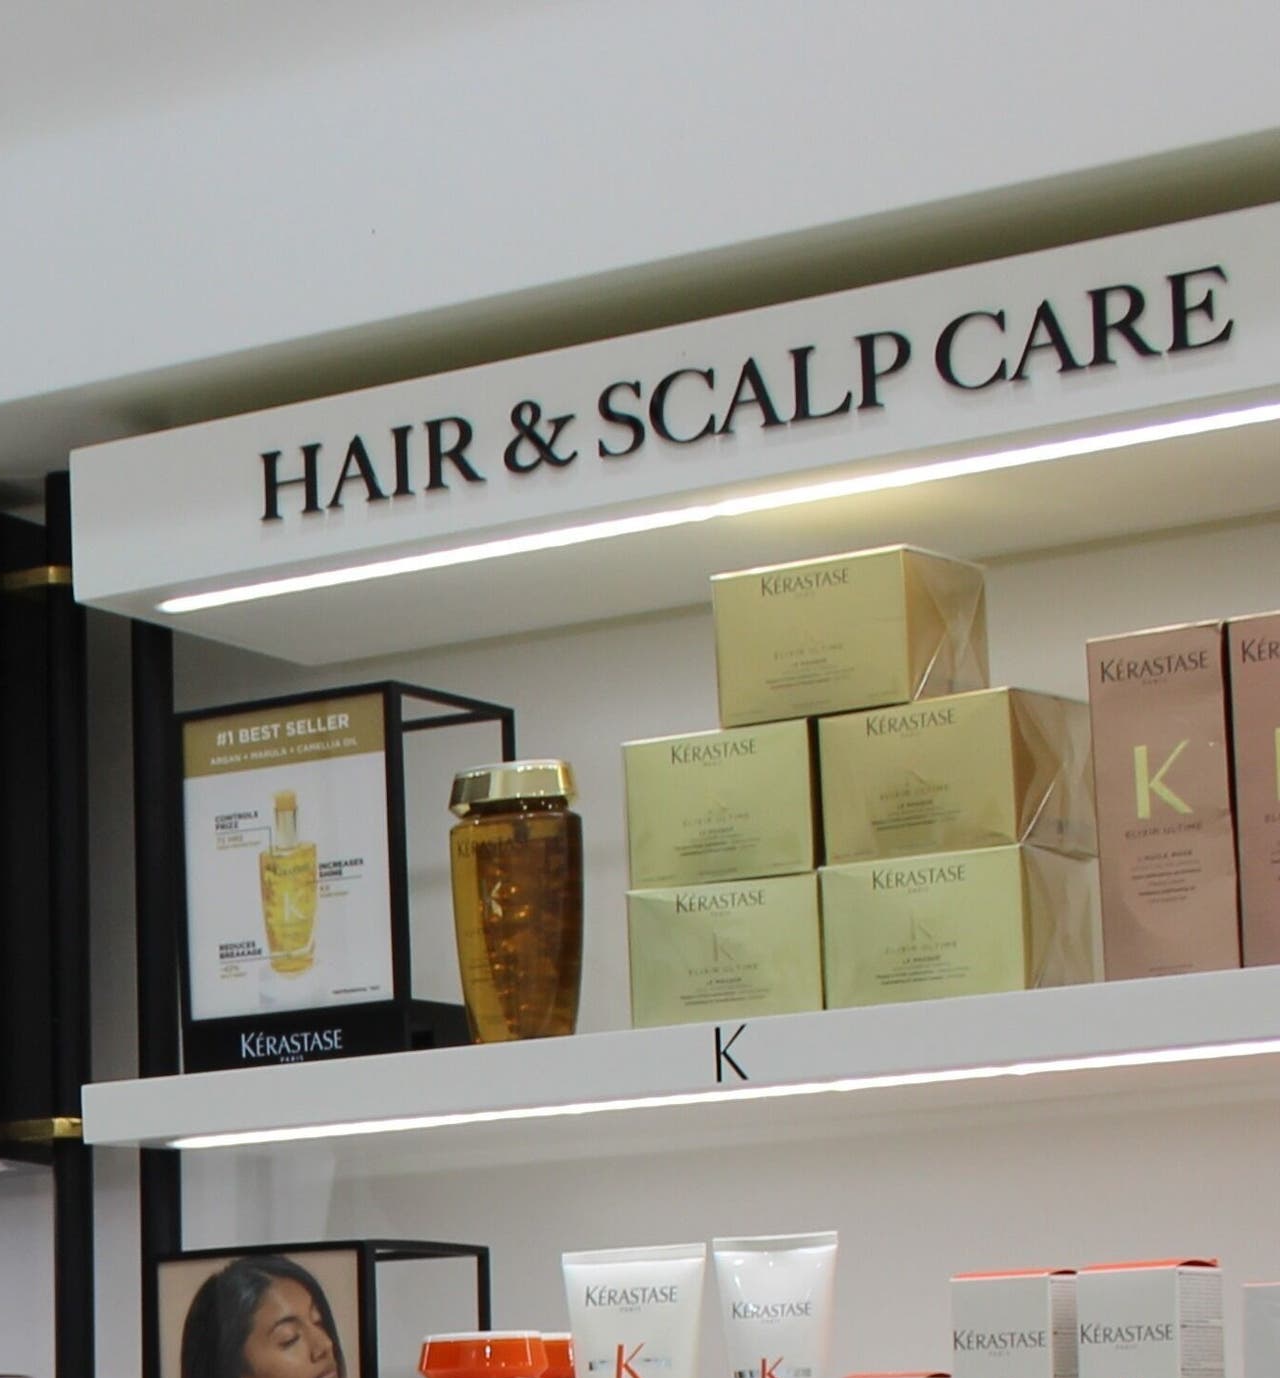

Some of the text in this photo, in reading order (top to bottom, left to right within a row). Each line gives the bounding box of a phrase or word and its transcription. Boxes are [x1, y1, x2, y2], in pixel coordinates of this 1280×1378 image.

[259, 264, 1235, 522] HAIR & SCALP CARE
[761, 567, 849, 598] KÉRASTASE
[1100, 649, 1210, 684] KÉRASTASE
[216, 713, 350, 747] #1 BEST SELLER
[865, 708, 956, 738] KÉRASTASE
[671, 738, 757, 765] KÉRASTASE
[1132, 738, 1195, 820] K
[872, 863, 967, 891] KÉRASTASE
[675, 888, 767, 915] KÉRASTASE
[241, 1028, 344, 1059] KÉRASTASE
[714, 1023, 749, 1083] K
[584, 1285, 678, 1308] KÉRASTASE
[731, 1300, 812, 1321] KÉRASTASE
[952, 1328, 1047, 1353] KÉRASTASE
[1079, 1321, 1175, 1345] KÉRASTASE
